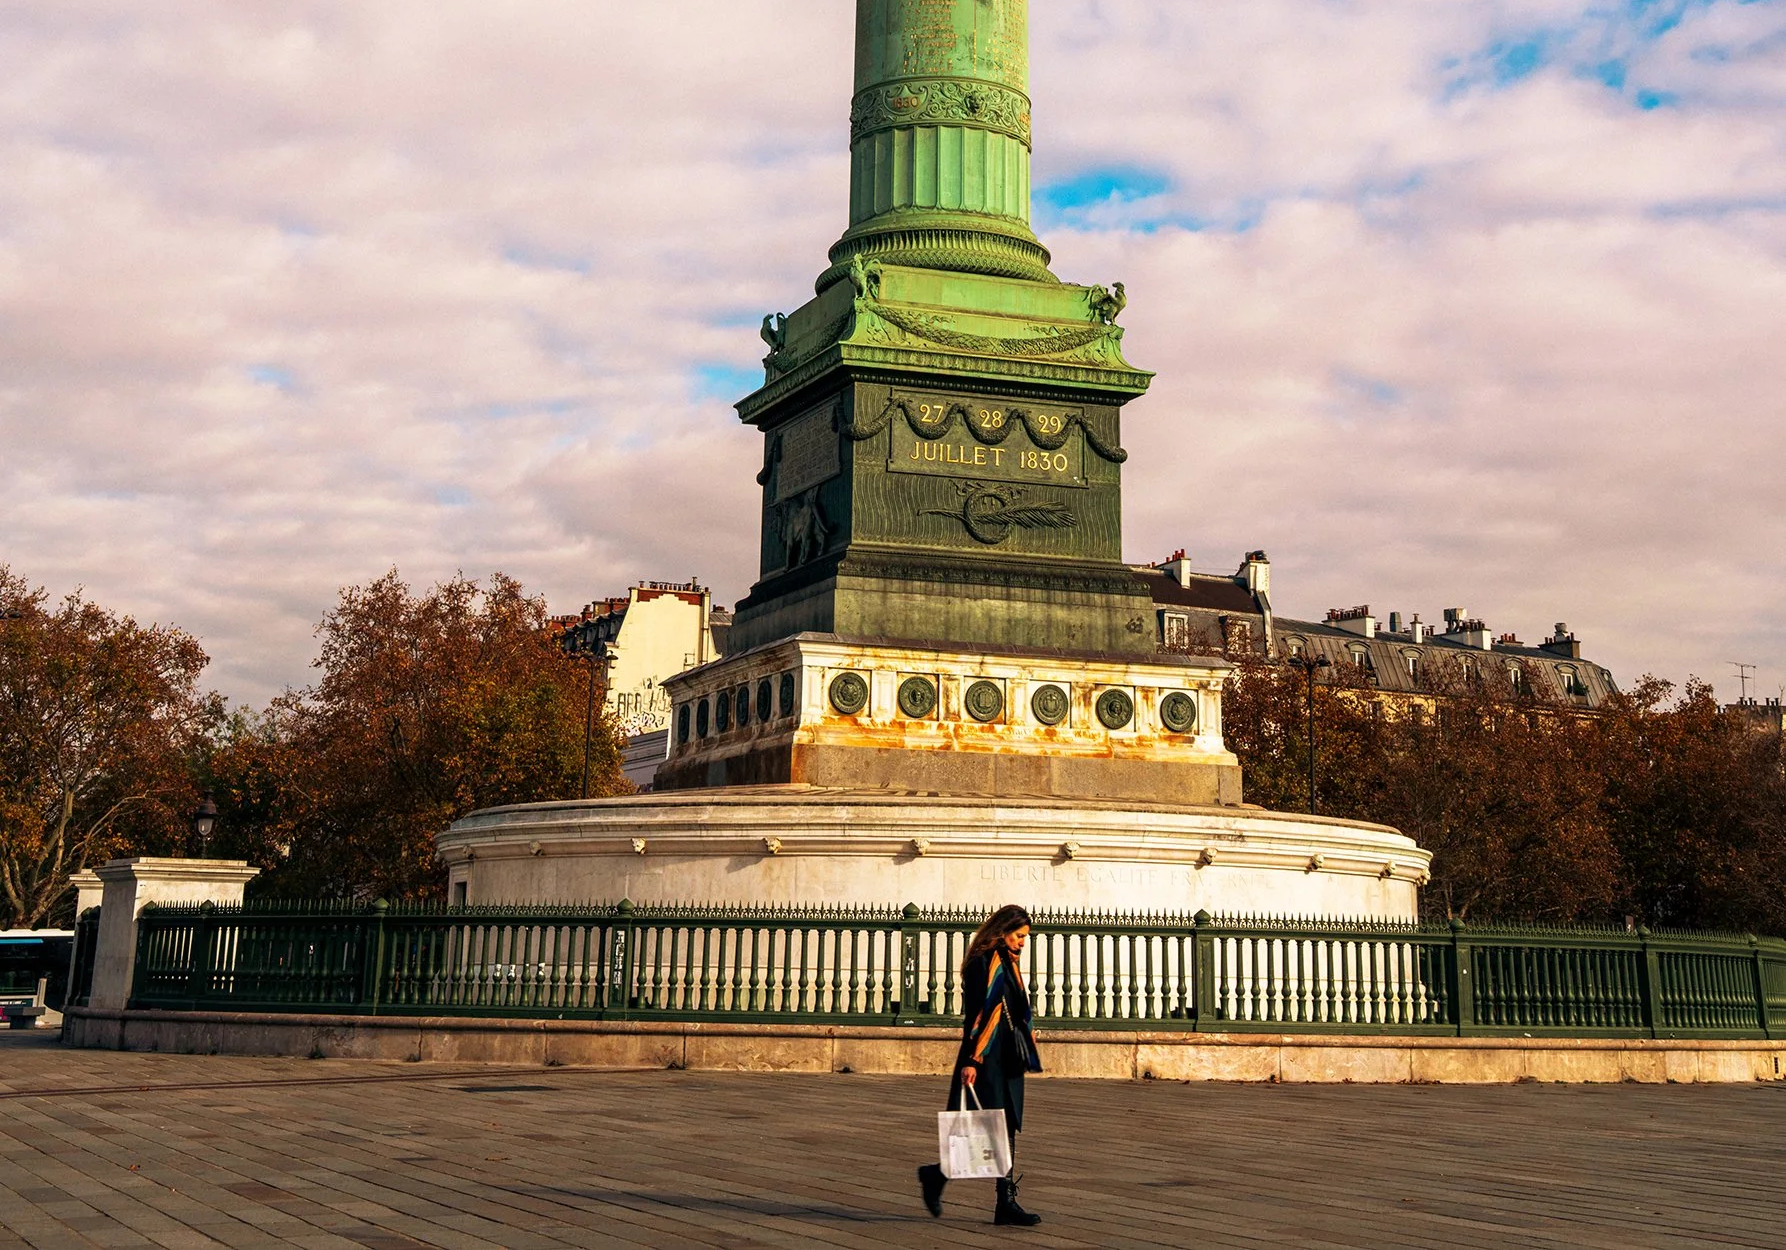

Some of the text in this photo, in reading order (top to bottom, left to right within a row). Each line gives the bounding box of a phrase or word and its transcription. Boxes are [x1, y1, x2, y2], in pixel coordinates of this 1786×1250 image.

[893, 96, 920, 109] 1830
[919, 404, 1061, 434] 27 28 29
[910, 441, 1068, 472] JUILLET 1830
[980, 864, 1275, 890] LIBERTE EGALITE FRARNITE
